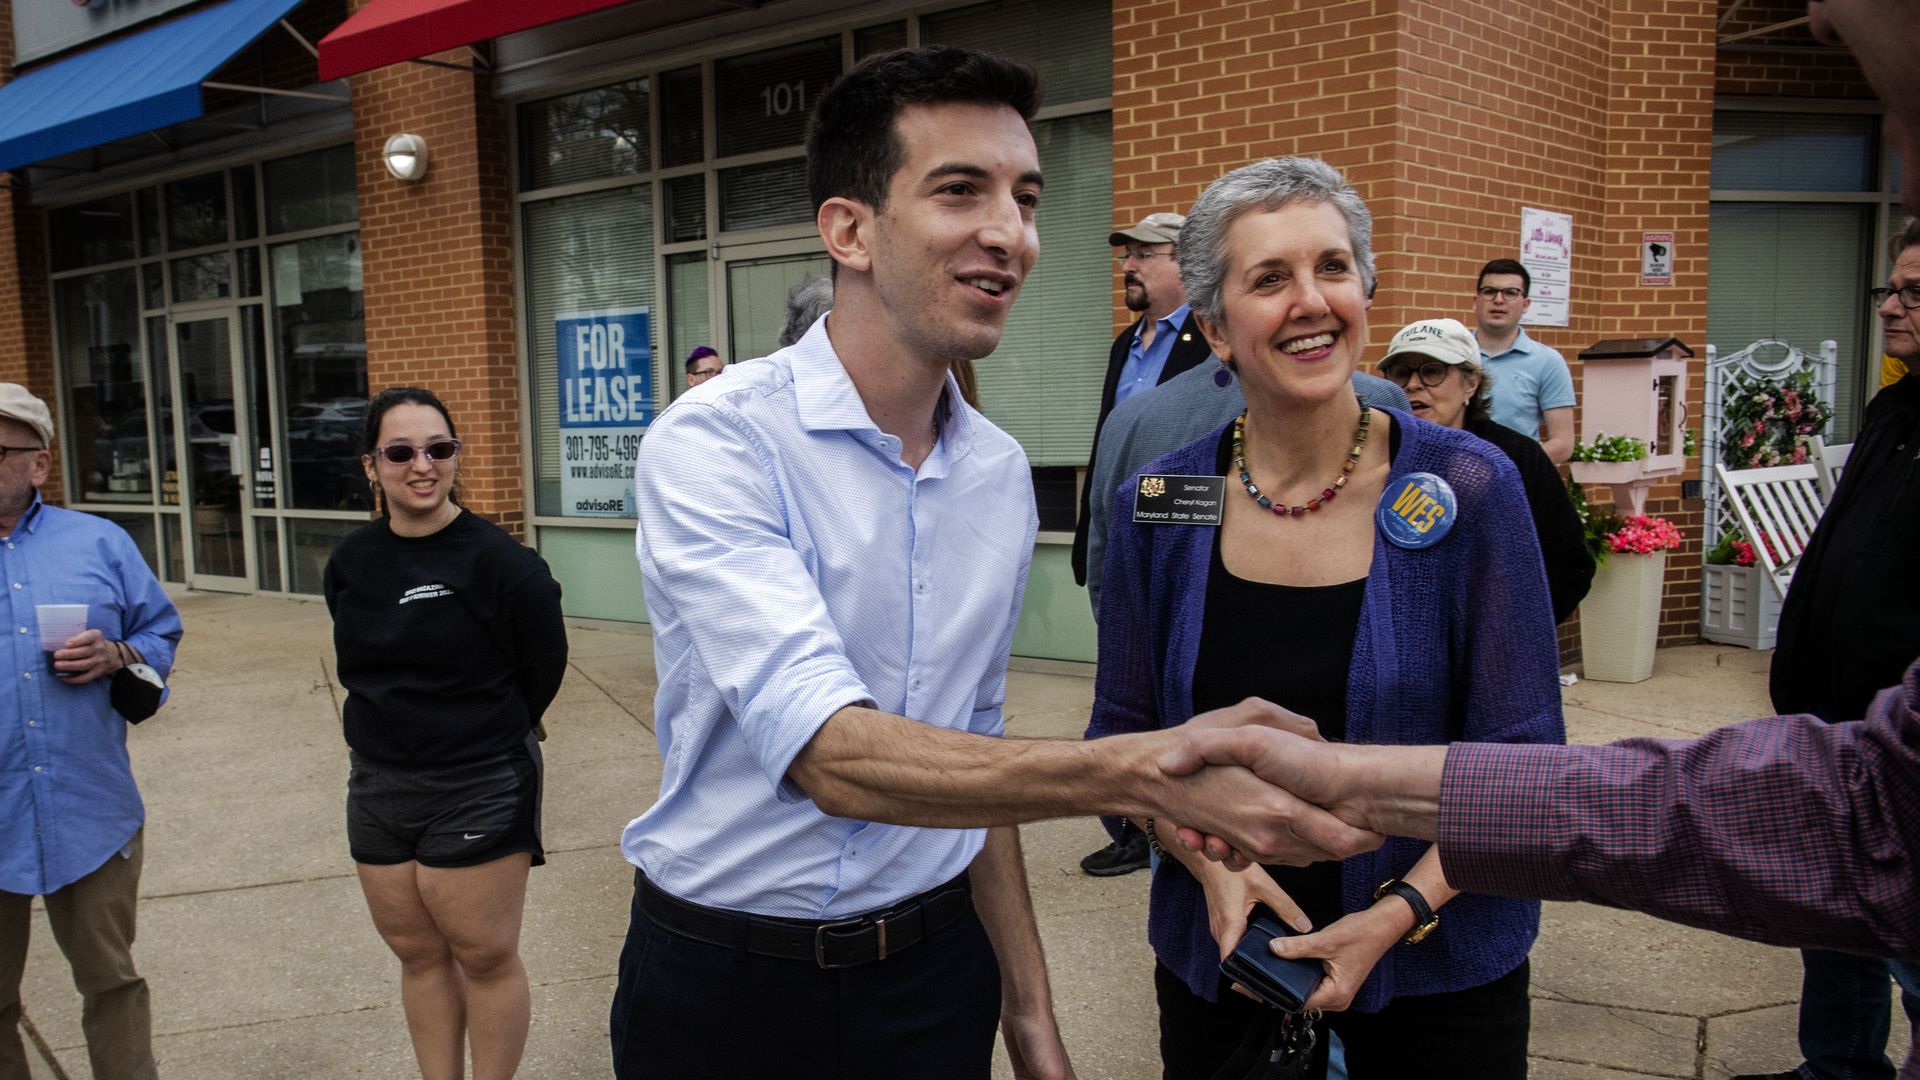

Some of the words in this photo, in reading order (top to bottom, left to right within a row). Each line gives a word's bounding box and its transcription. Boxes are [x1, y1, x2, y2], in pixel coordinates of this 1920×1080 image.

[760, 80, 805, 117] 101
[1400, 325, 1444, 341] TULANE
[576, 323, 626, 371] FOR
[566, 375, 644, 422] LEASE
[566, 434, 643, 461] 301-795-496
[570, 463, 635, 479] www.advisoRE.co
[1183, 484, 1210, 492] Senator
[576, 499, 624, 511] advisoRE
[1173, 498, 1194, 506] Cheryl
[1194, 499, 1217, 507] Kagan
[1391, 481, 1446, 533] WES
[1136, 511, 1169, 519] Maryland
[1171, 512, 1190, 520] State
